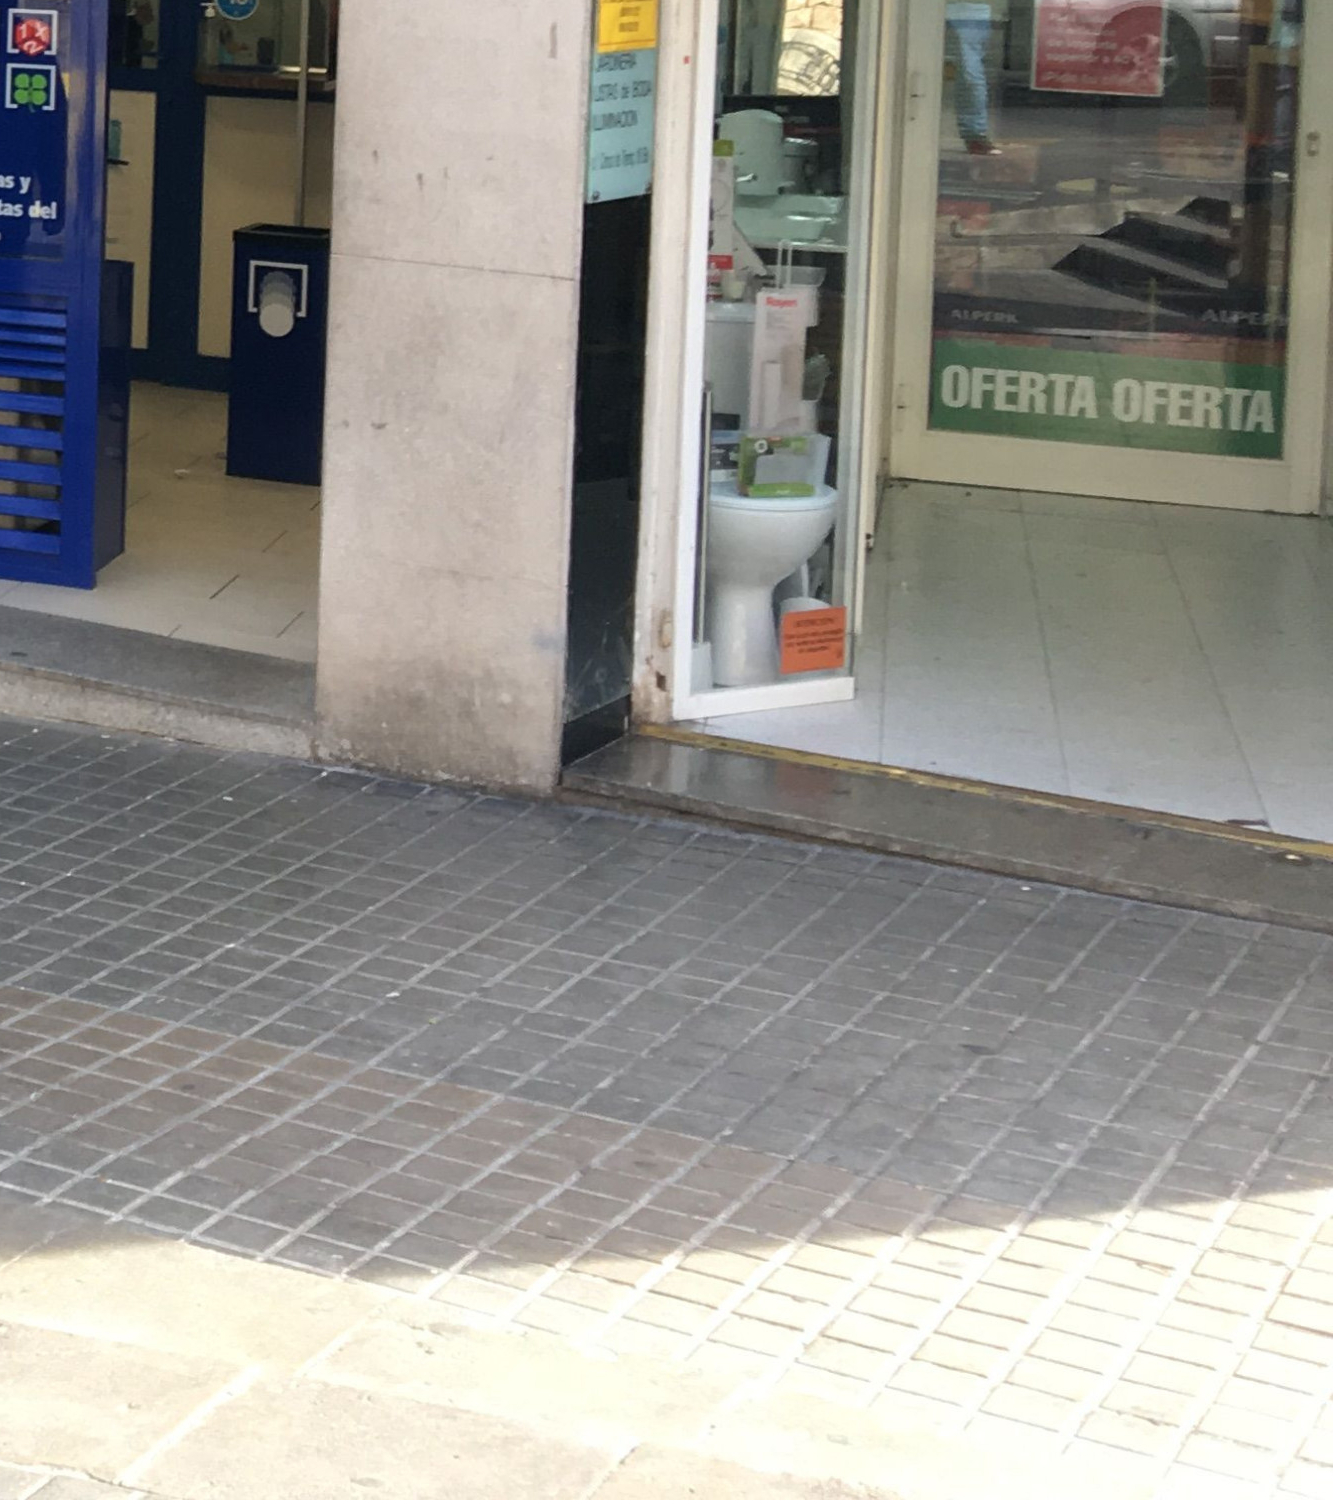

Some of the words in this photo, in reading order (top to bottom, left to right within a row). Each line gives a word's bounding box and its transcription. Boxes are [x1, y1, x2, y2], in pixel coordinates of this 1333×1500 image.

[19, 175, 31, 194] y
[28, 202, 57, 220] del
[941, 365, 1099, 419] OFERTA
[1112, 378, 1276, 434] OFERTA
